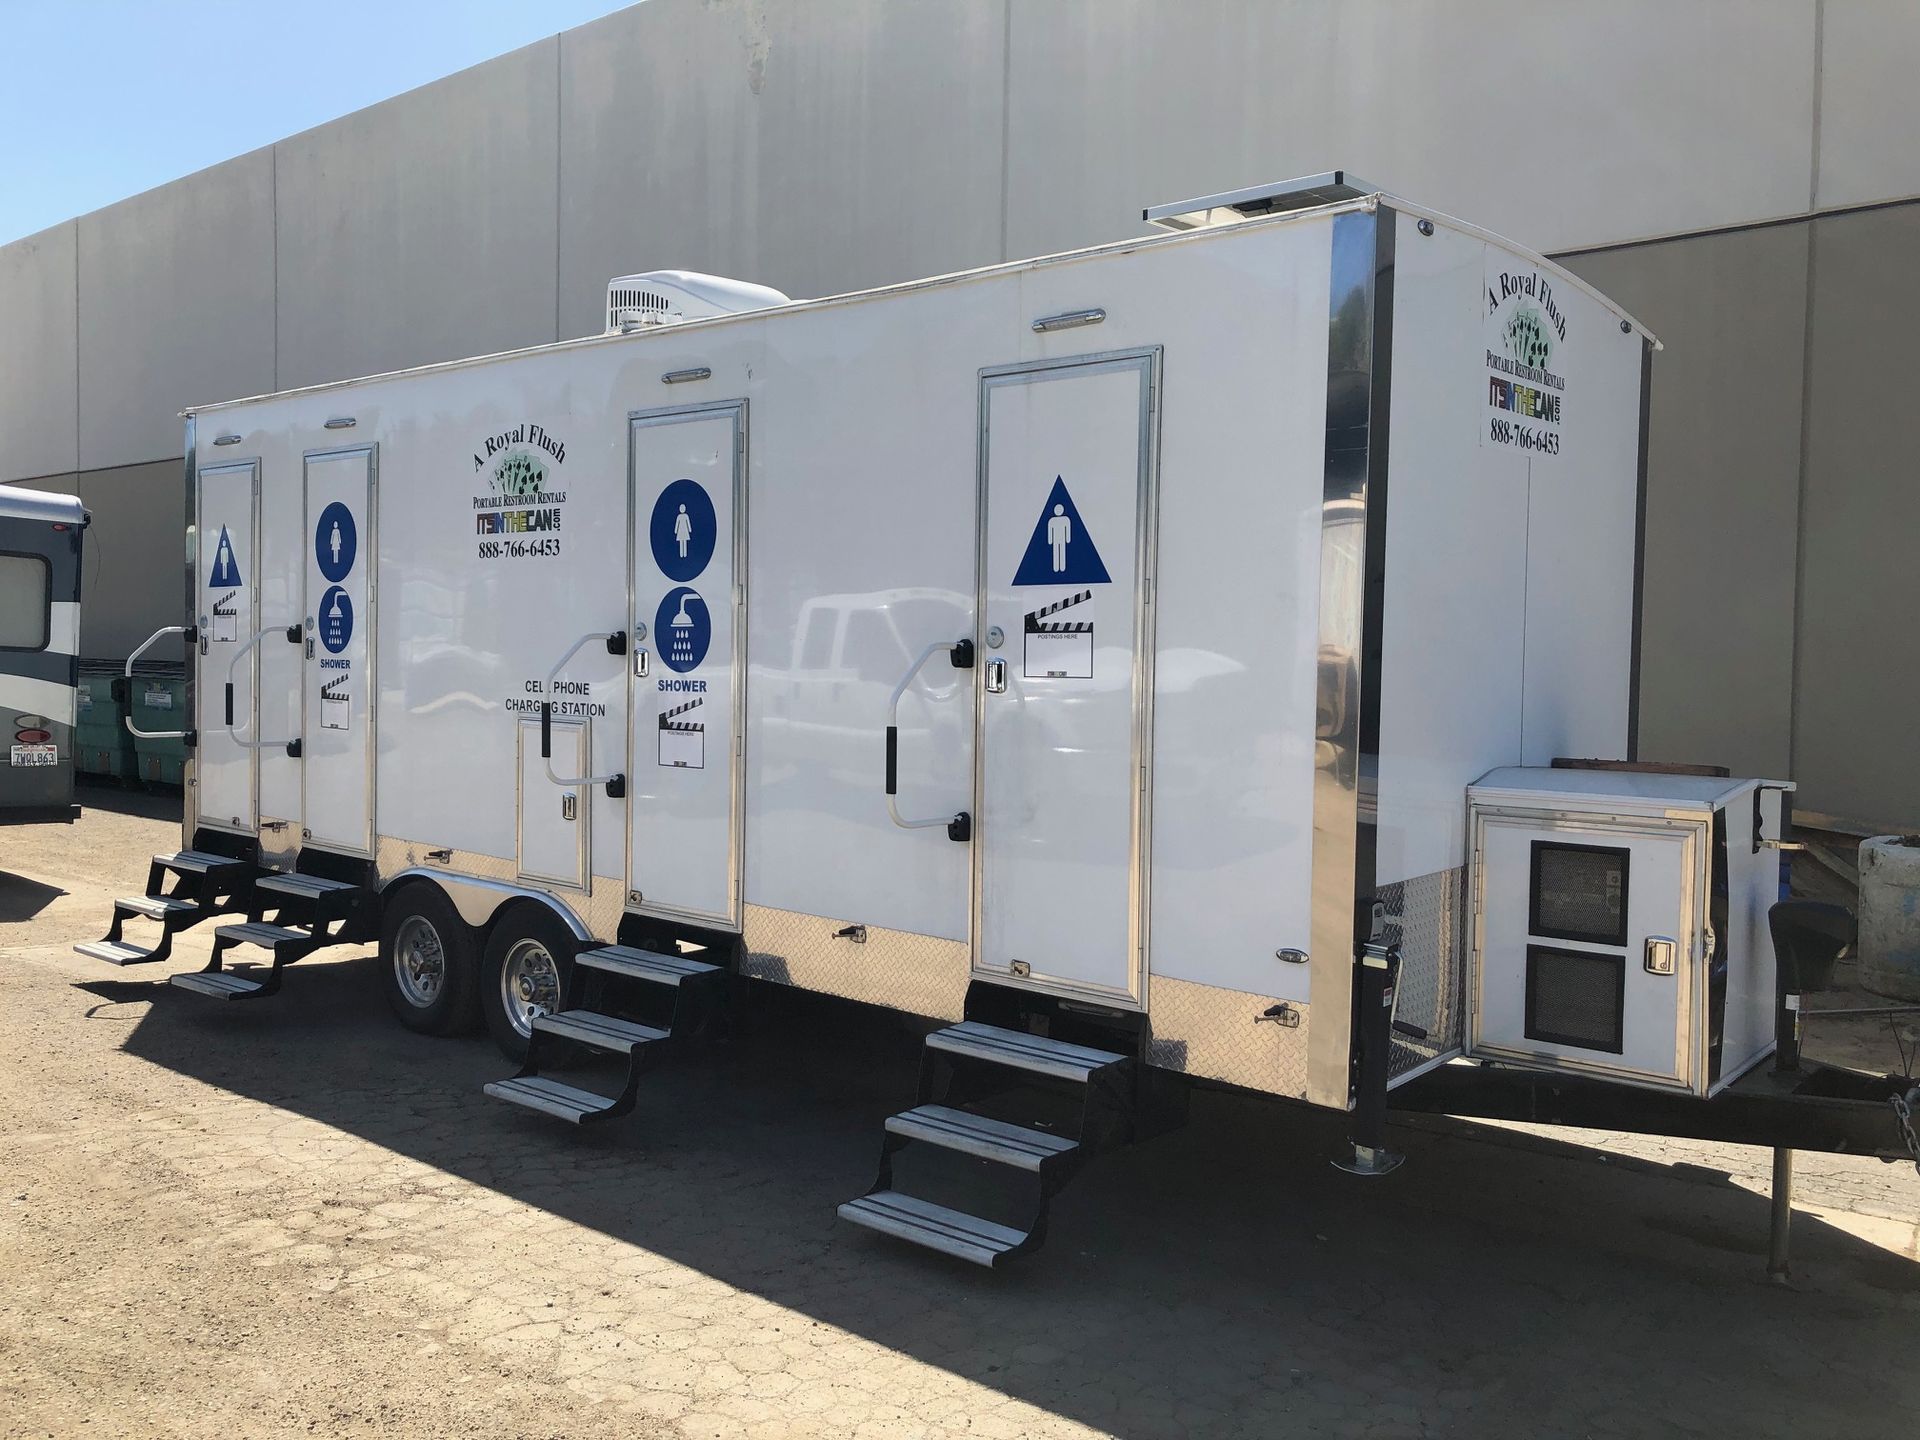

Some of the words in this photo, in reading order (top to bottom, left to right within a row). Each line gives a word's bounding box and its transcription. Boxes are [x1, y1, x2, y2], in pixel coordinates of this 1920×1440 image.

[1489, 287, 1499, 316] A
[1499, 272, 1537, 301] Royal
[1539, 278, 1567, 343] Flush
[1490, 417, 1560, 455] 888-766-6453
[473, 453, 485, 473] A
[484, 423, 525, 458] Royal
[527, 424, 566, 464] Flush
[473, 496, 502, 509] PORTABLE
[503, 494, 536, 507] RESTROOM
[537, 491, 567, 504] RENTALS
[478, 538, 561, 559] 888-766-6453
[320, 658, 351, 669] SHOWER
[553, 681, 590, 695] PHONE
[657, 679, 707, 692] SHOWER
[561, 701, 606, 717] STATION
